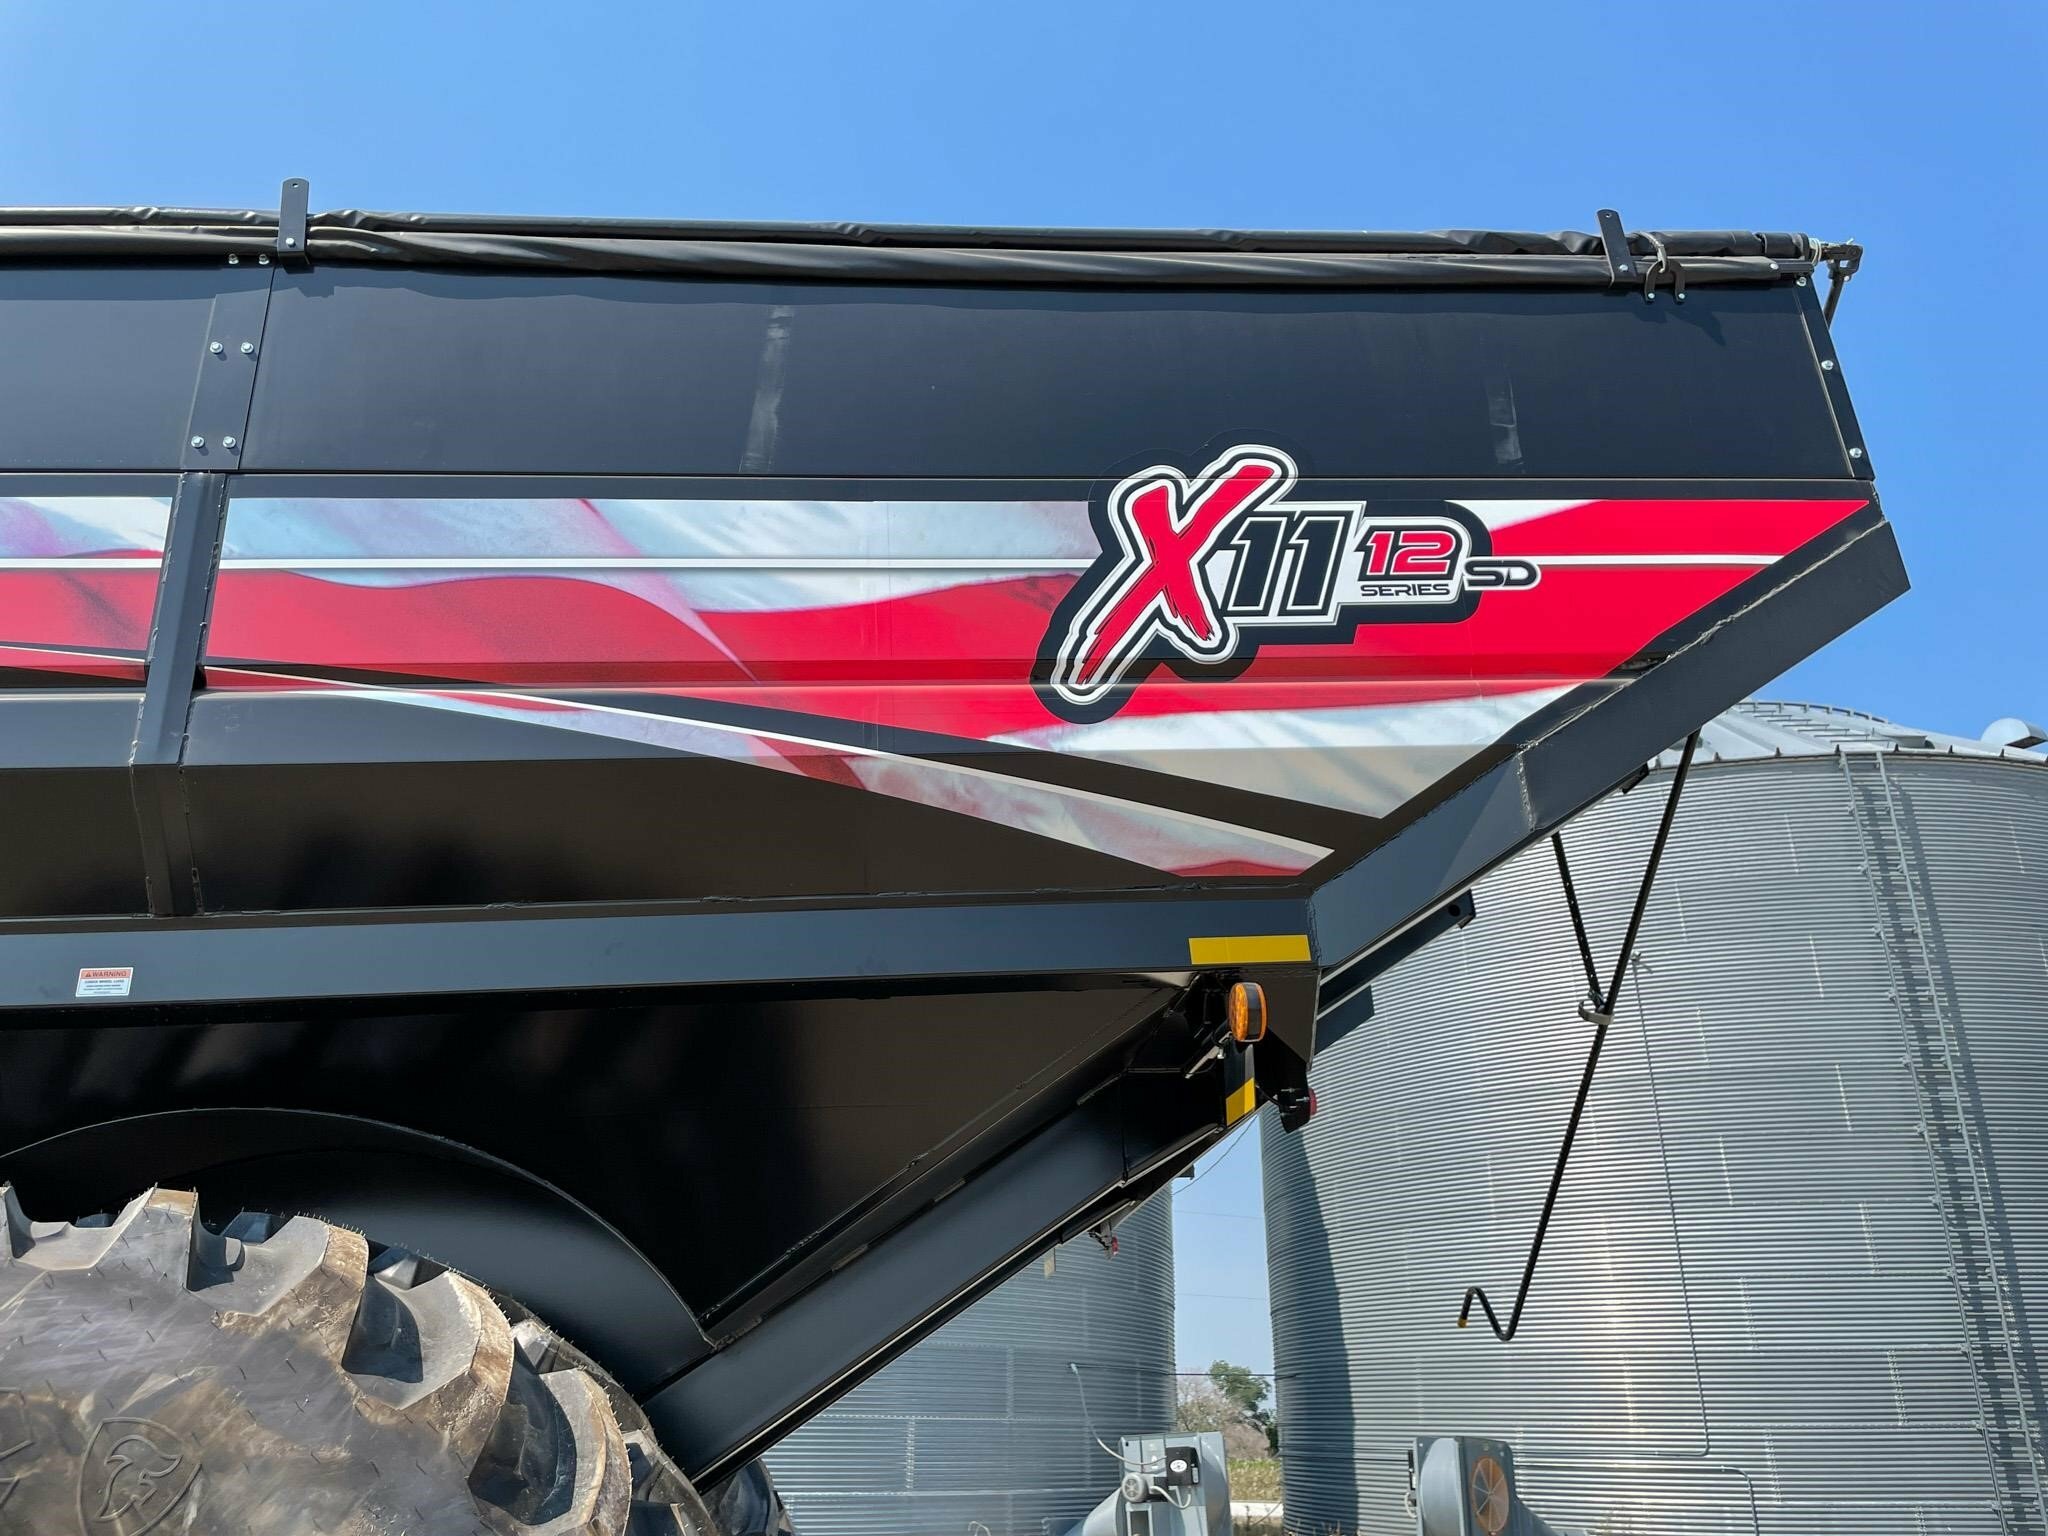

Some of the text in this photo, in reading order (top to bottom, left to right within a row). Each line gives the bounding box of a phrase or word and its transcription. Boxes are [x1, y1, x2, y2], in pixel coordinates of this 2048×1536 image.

[1056, 448, 1460, 700] X11 12
[1465, 559, 1541, 589] SD
[1360, 583, 1451, 597] SERIES
